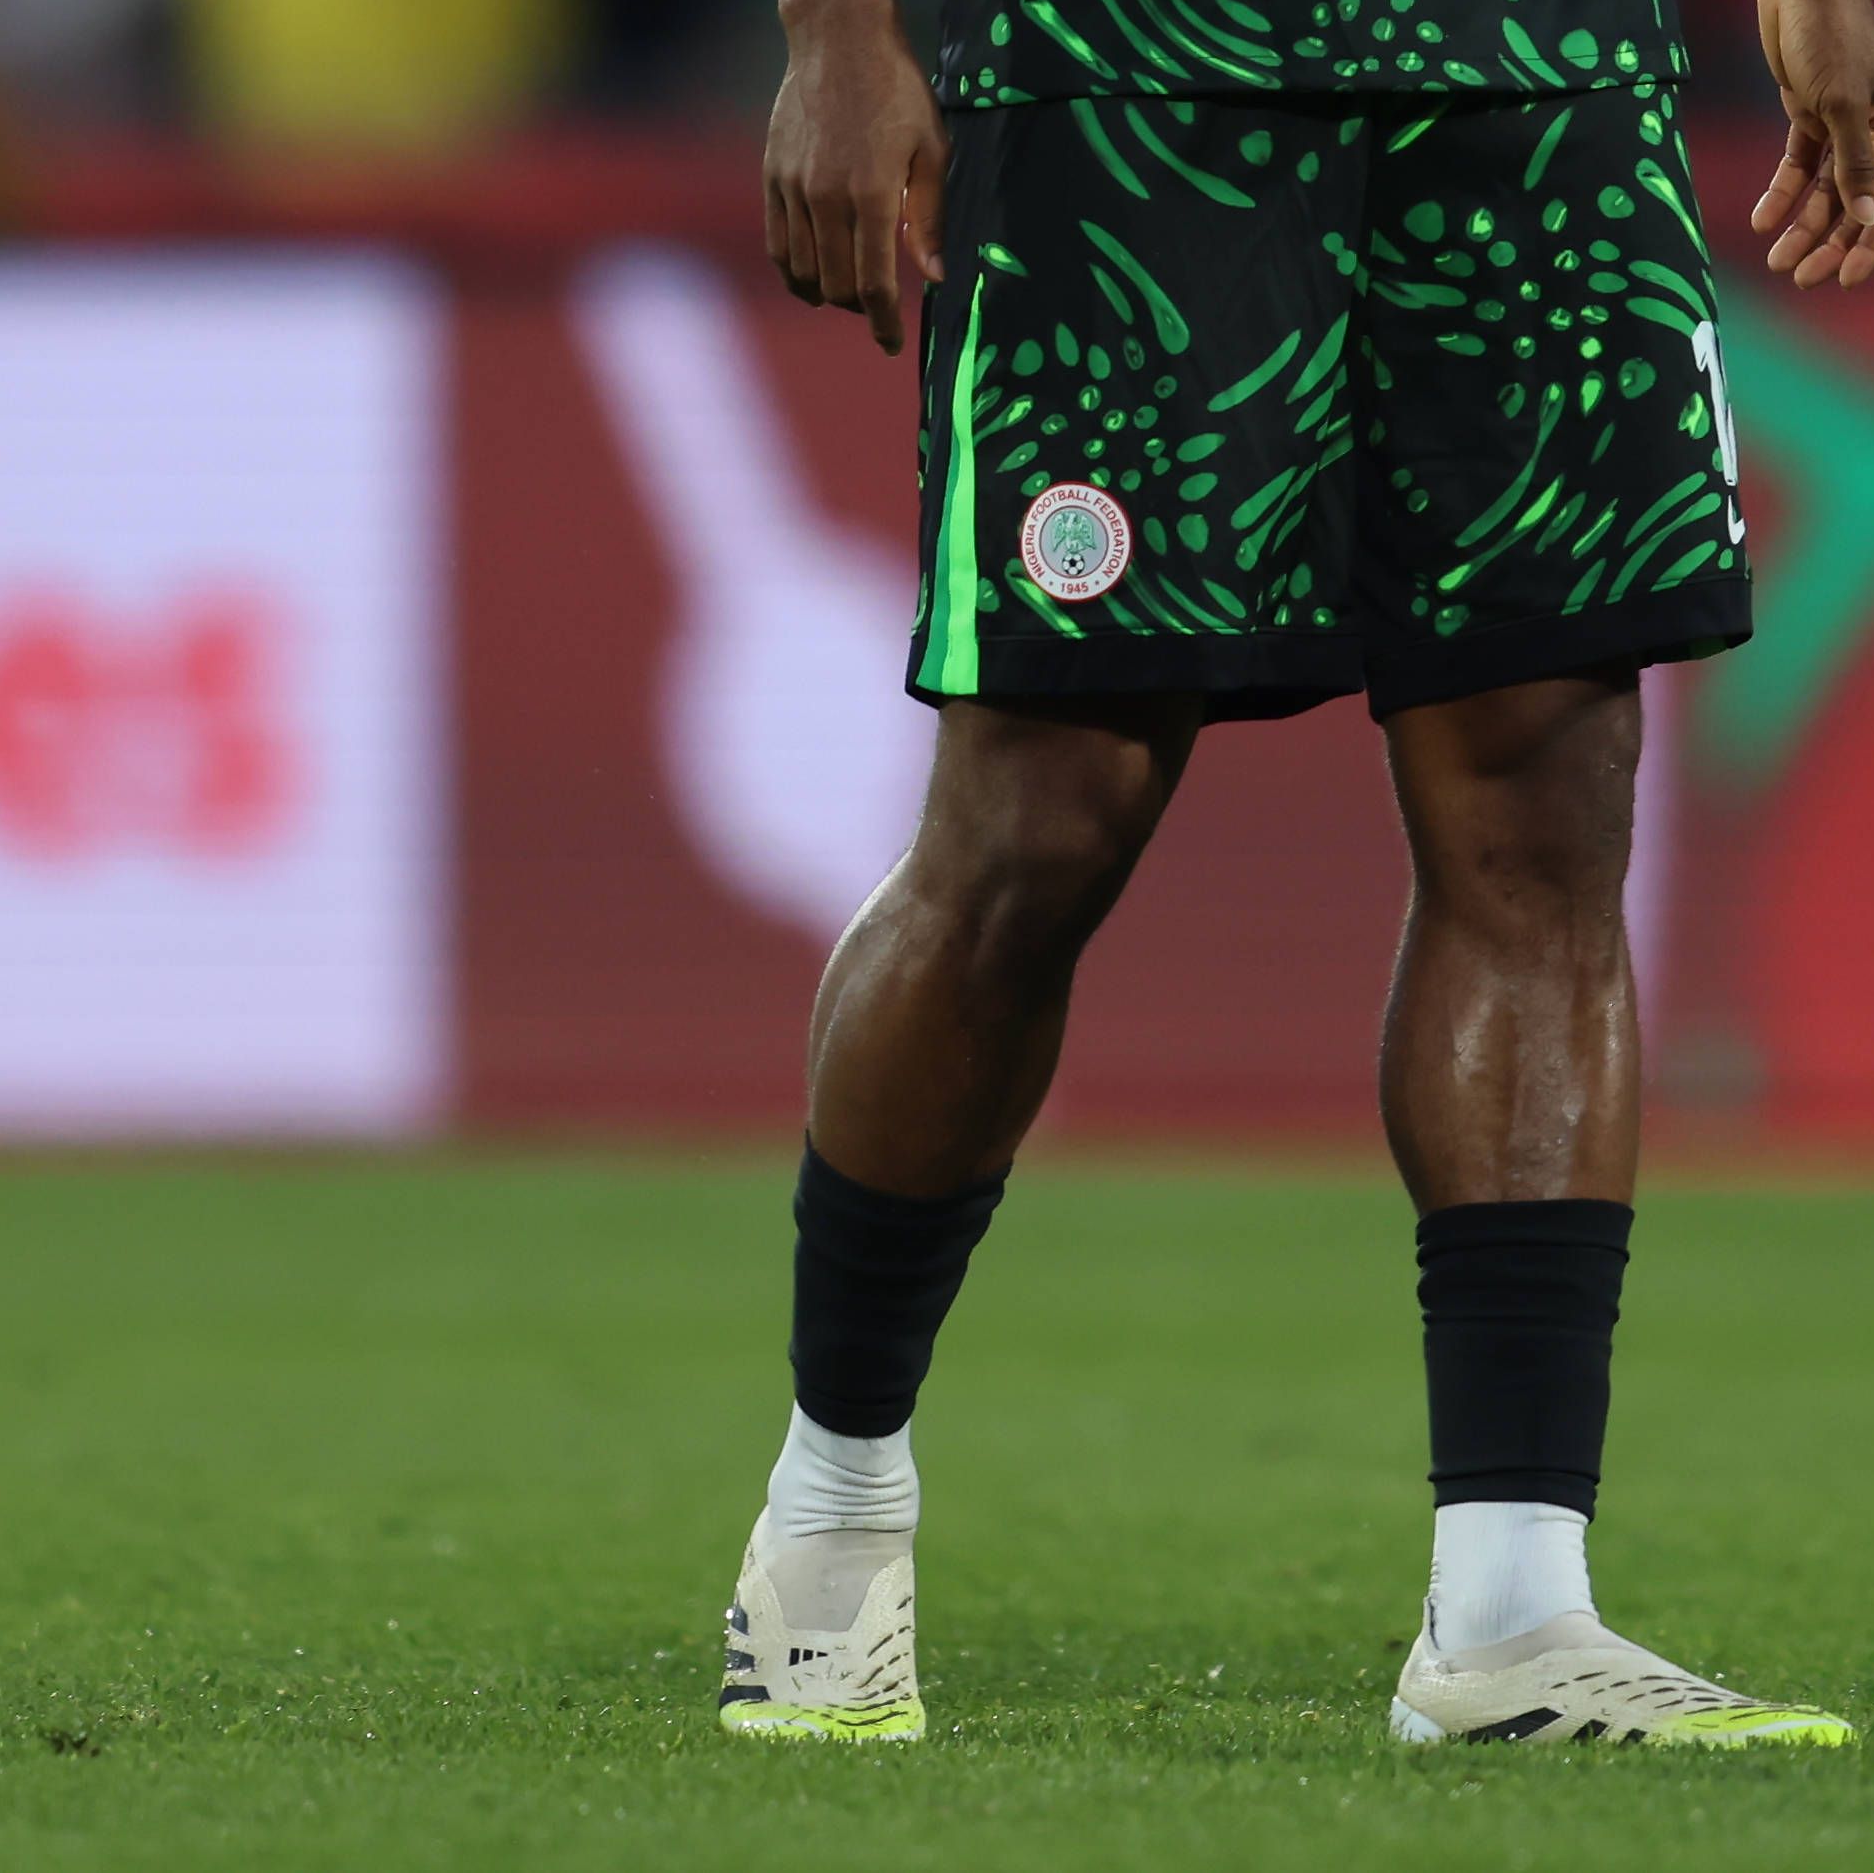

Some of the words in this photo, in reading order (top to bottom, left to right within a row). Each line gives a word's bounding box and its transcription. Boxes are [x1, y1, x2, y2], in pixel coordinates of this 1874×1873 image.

[1032, 490, 1090, 521] FOOTBALL
[1025, 525, 1045, 578] NIGERIA
[1093, 497, 1124, 578] FEDERATION
[1061, 582, 1089, 593] 1945
